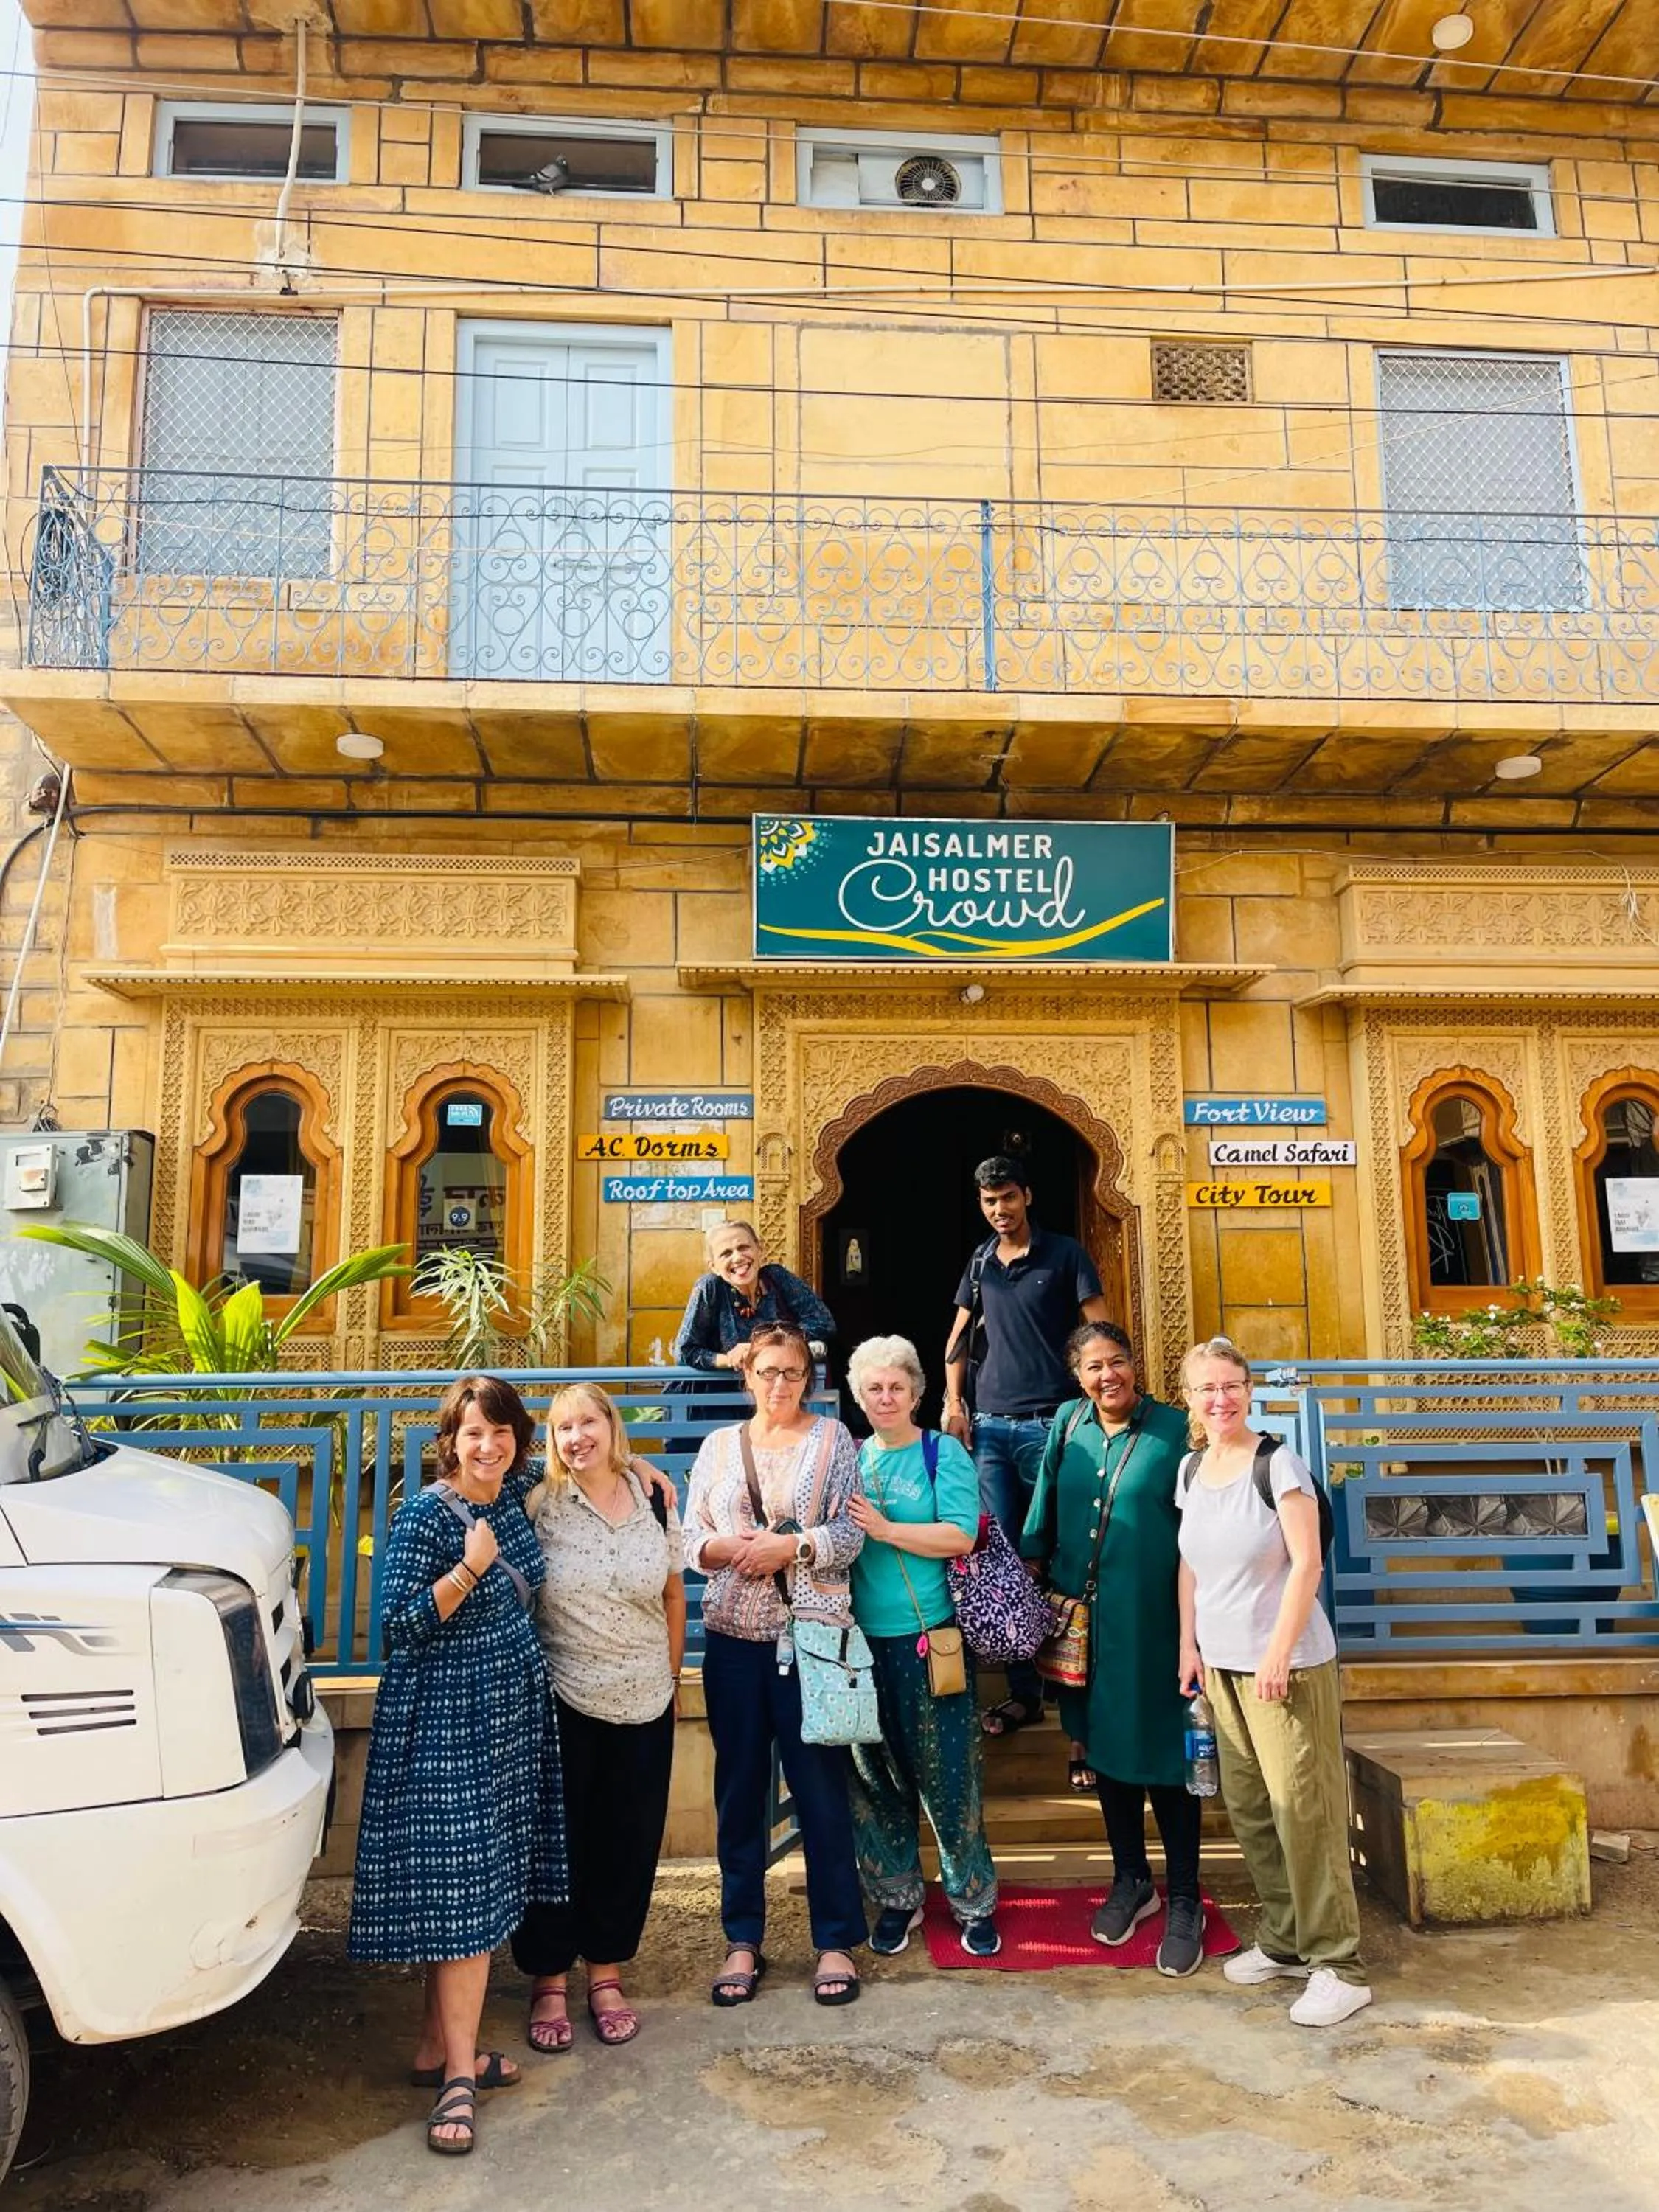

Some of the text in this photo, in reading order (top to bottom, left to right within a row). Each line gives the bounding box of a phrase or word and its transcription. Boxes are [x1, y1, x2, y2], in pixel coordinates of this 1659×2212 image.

[866, 832, 1053, 859] JAISALMER
[928, 867, 1052, 893] HOSTEL
[838, 855, 1086, 931] Crowd
[610, 1096, 749, 1116] Private Rooms
[1193, 1102, 1318, 1121] Fort View
[635, 1136, 719, 1157] Dorms
[1214, 1142, 1349, 1164] Camel Safari
[701, 1178, 750, 1198] Area
[1195, 1185, 1318, 1207] City Tour
[451, 1212, 469, 1222] 9.9
